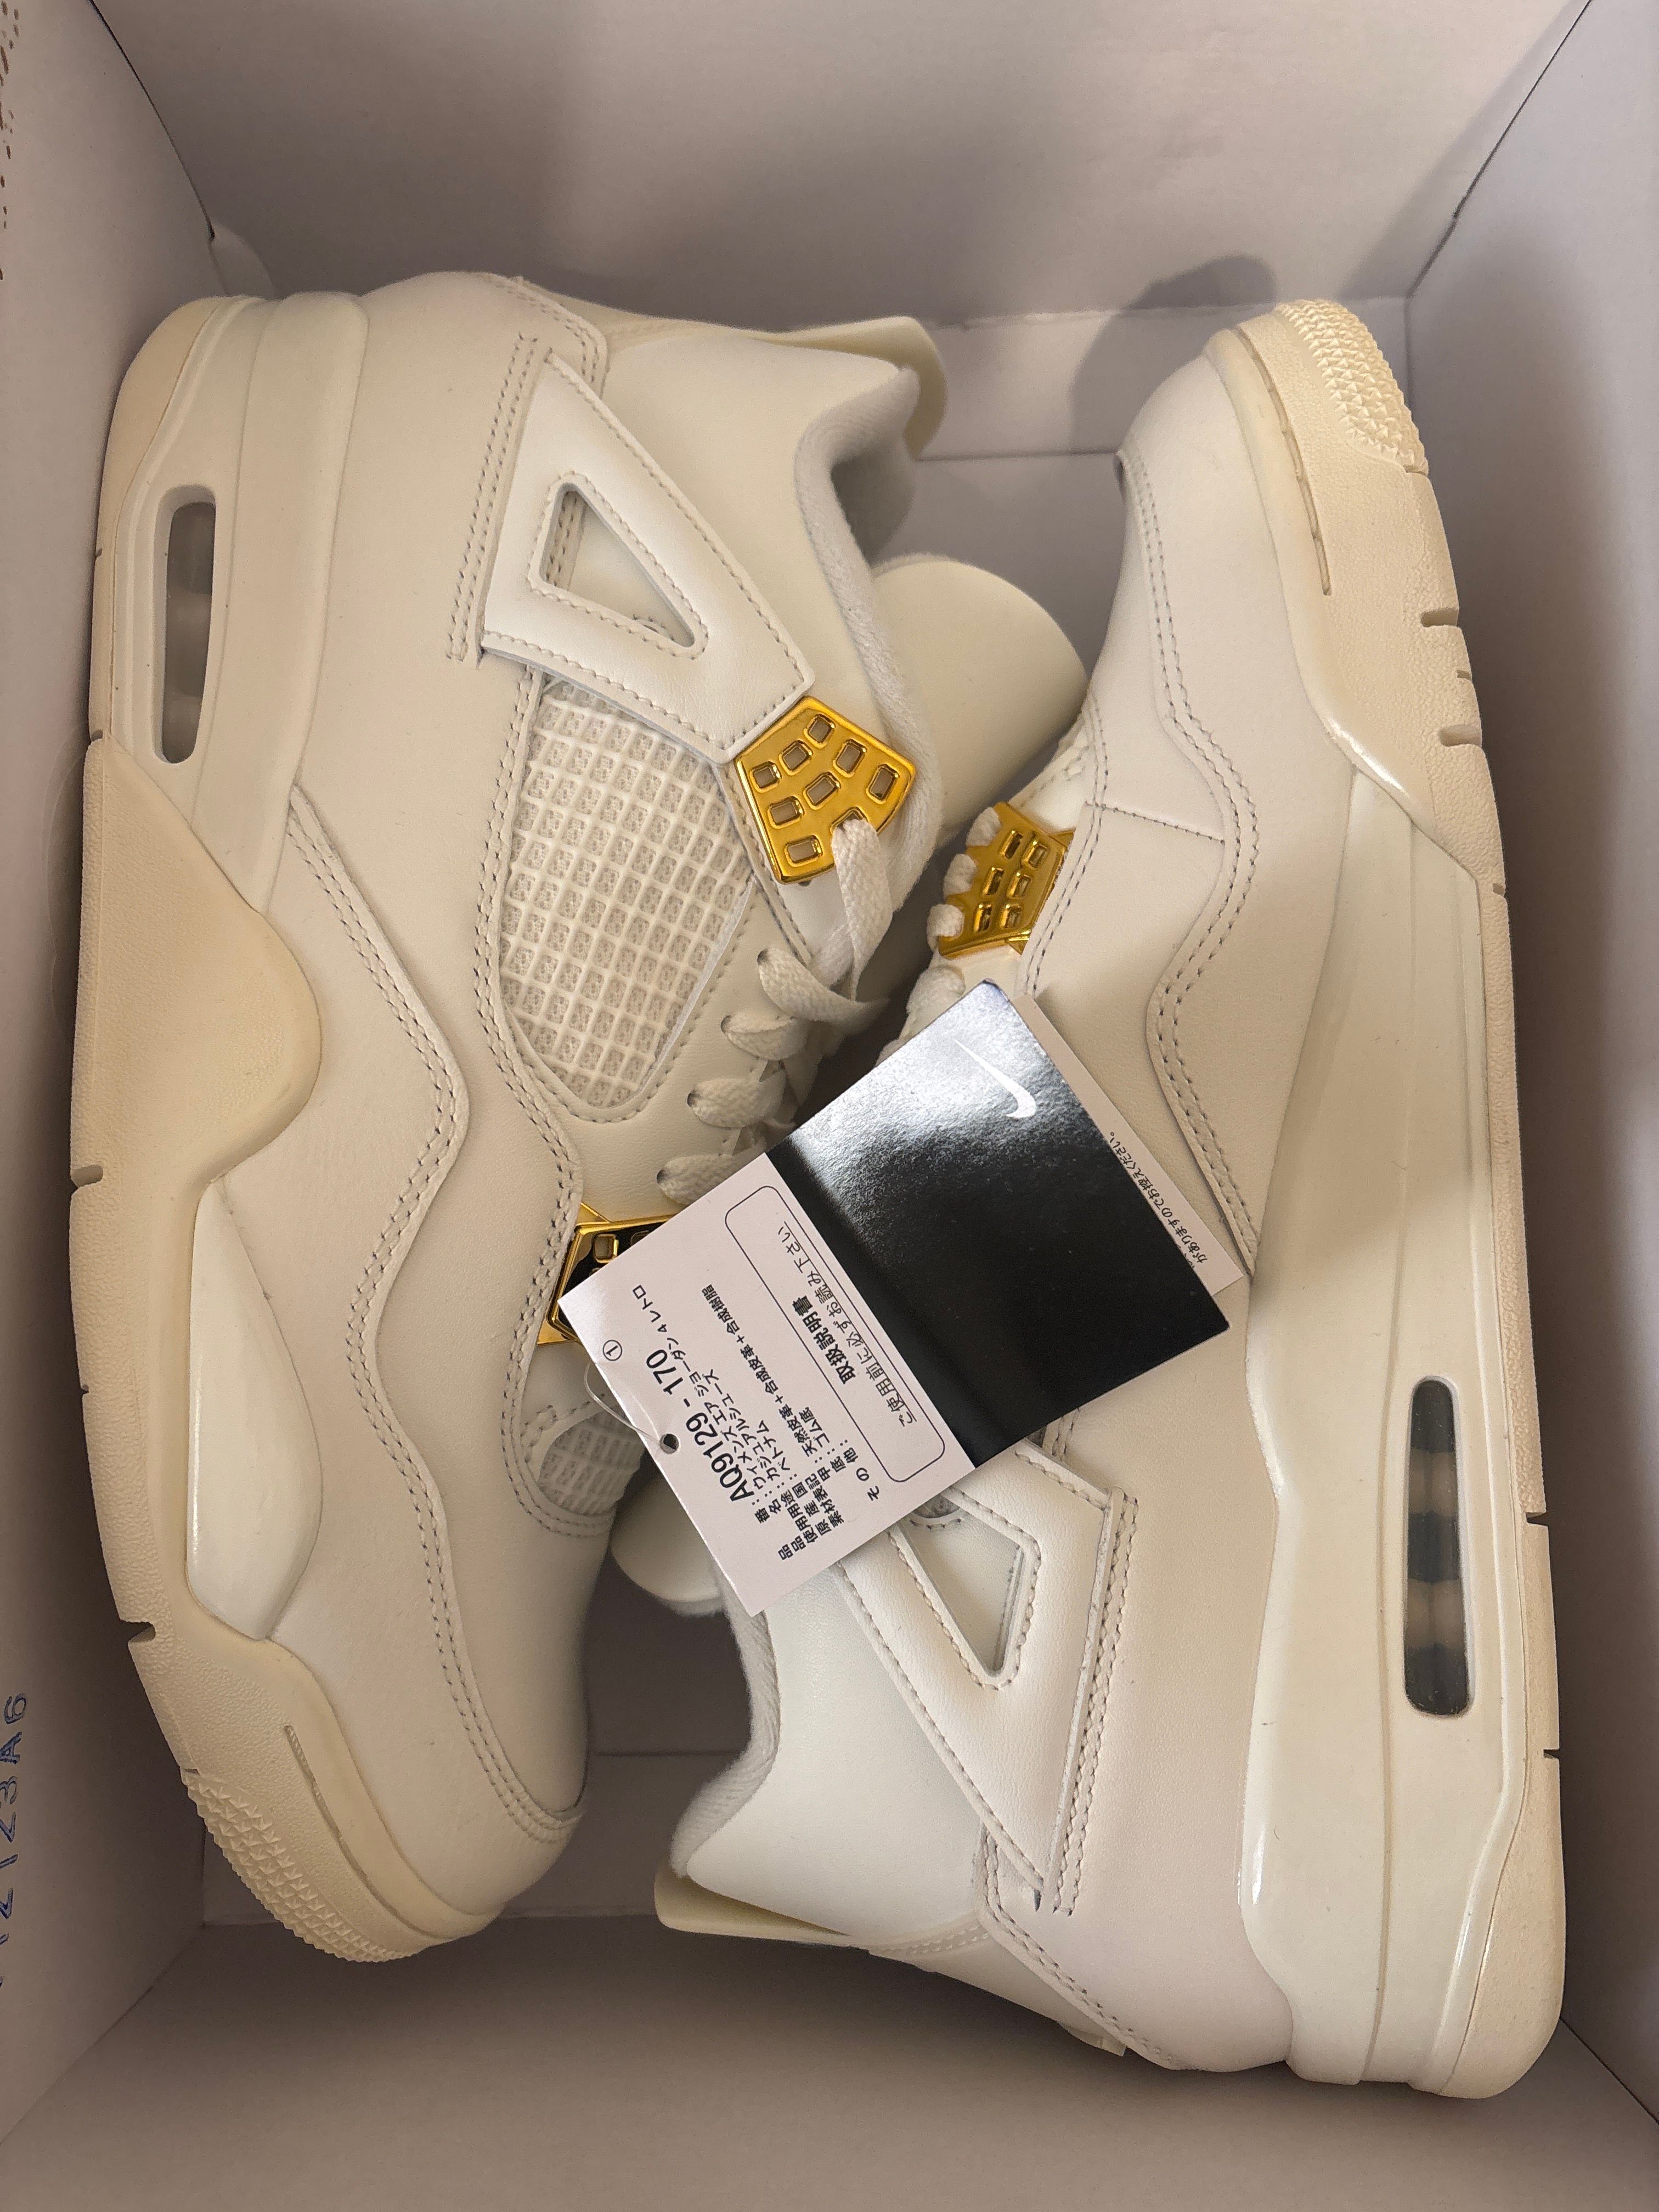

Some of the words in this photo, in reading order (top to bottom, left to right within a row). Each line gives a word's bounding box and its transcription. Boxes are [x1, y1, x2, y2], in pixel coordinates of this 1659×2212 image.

[778, 1226, 917, 1426] ご使用前に必ずお読み下さい
[792, 1295, 856, 1384] 取扱説明書
[646, 1349, 683, 1395] 170
[667, 1338, 709, 1397] ジョーダン
[704, 1402, 727, 1425] エア
[798, 1407, 830, 1447] ゴム底
[686, 1412, 754, 1501] AQ9129
[756, 1420, 790, 1470] ベトナム
[804, 1473, 844, 1527] 素材表記
